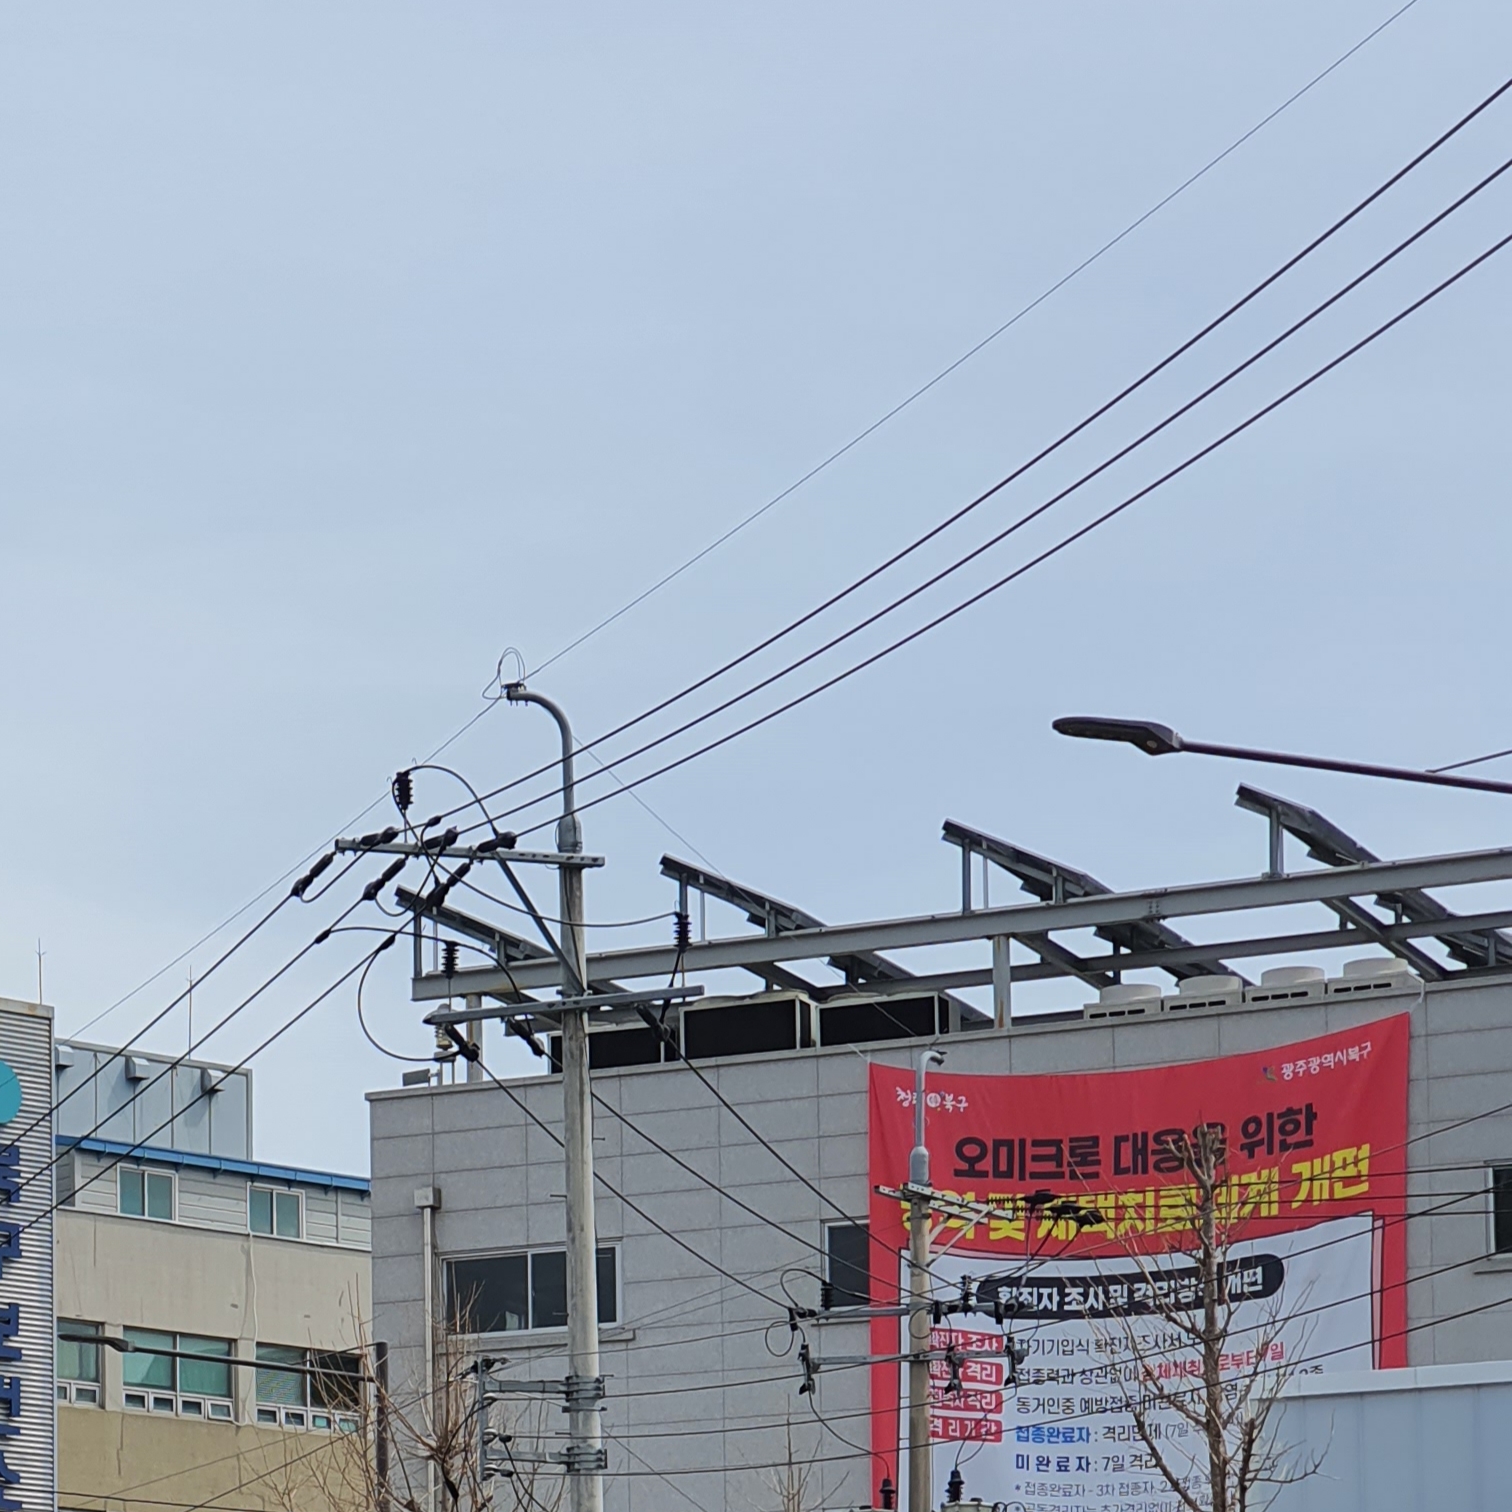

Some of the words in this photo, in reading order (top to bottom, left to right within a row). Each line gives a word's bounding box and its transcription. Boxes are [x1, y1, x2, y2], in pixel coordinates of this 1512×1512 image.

[1281, 1041, 1372, 1081] 광주광역시북구
[953, 1136, 1103, 1181] 오미크론
[1113, 1122, 1227, 1176] 대응을
[1240, 1102, 1317, 1160] 위한
[1291, 1143, 1371, 1210] 개편
[1064, 1287, 1104, 1311] 조사
[1133, 1277, 1207, 1306] 격리방
[966, 1363, 996, 1382] 격리
[1016, 1397, 1075, 1415] 동거인중
[1015, 1425, 1091, 1444] 접종완료자
[1101, 1455, 1125, 1472] 7일
[1024, 1480, 1086, 1498] 접종완료자
[1096, 1483, 1116, 1497] 3차
